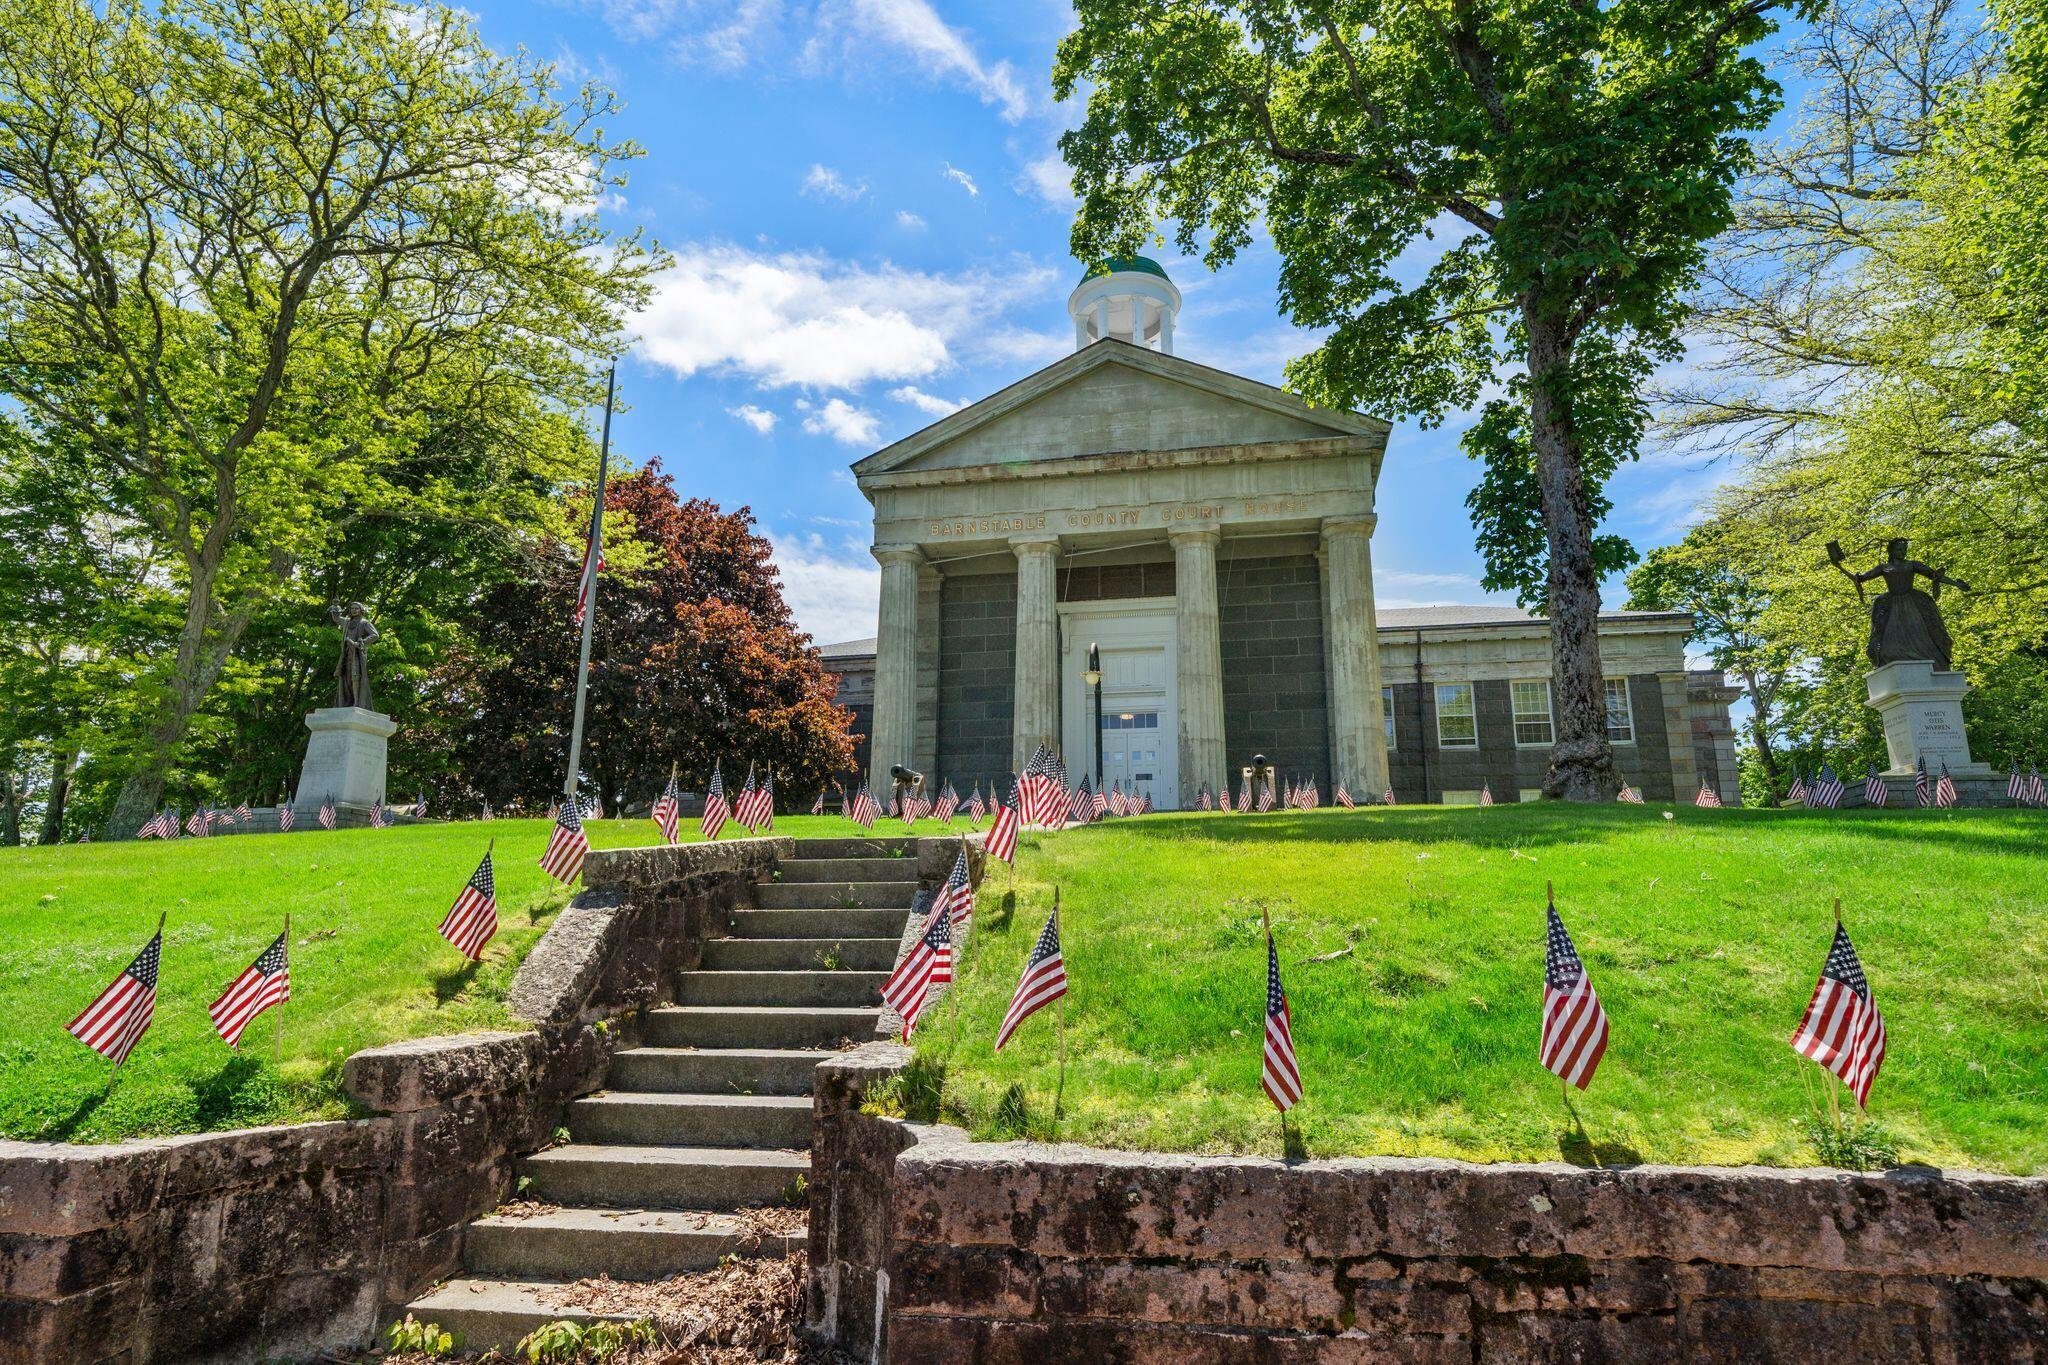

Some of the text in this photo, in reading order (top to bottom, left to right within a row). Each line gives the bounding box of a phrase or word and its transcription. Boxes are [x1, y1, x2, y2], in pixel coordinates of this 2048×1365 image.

[930, 499, 1308, 536] BARNSTABLE COUNTY COURT HOUSE
